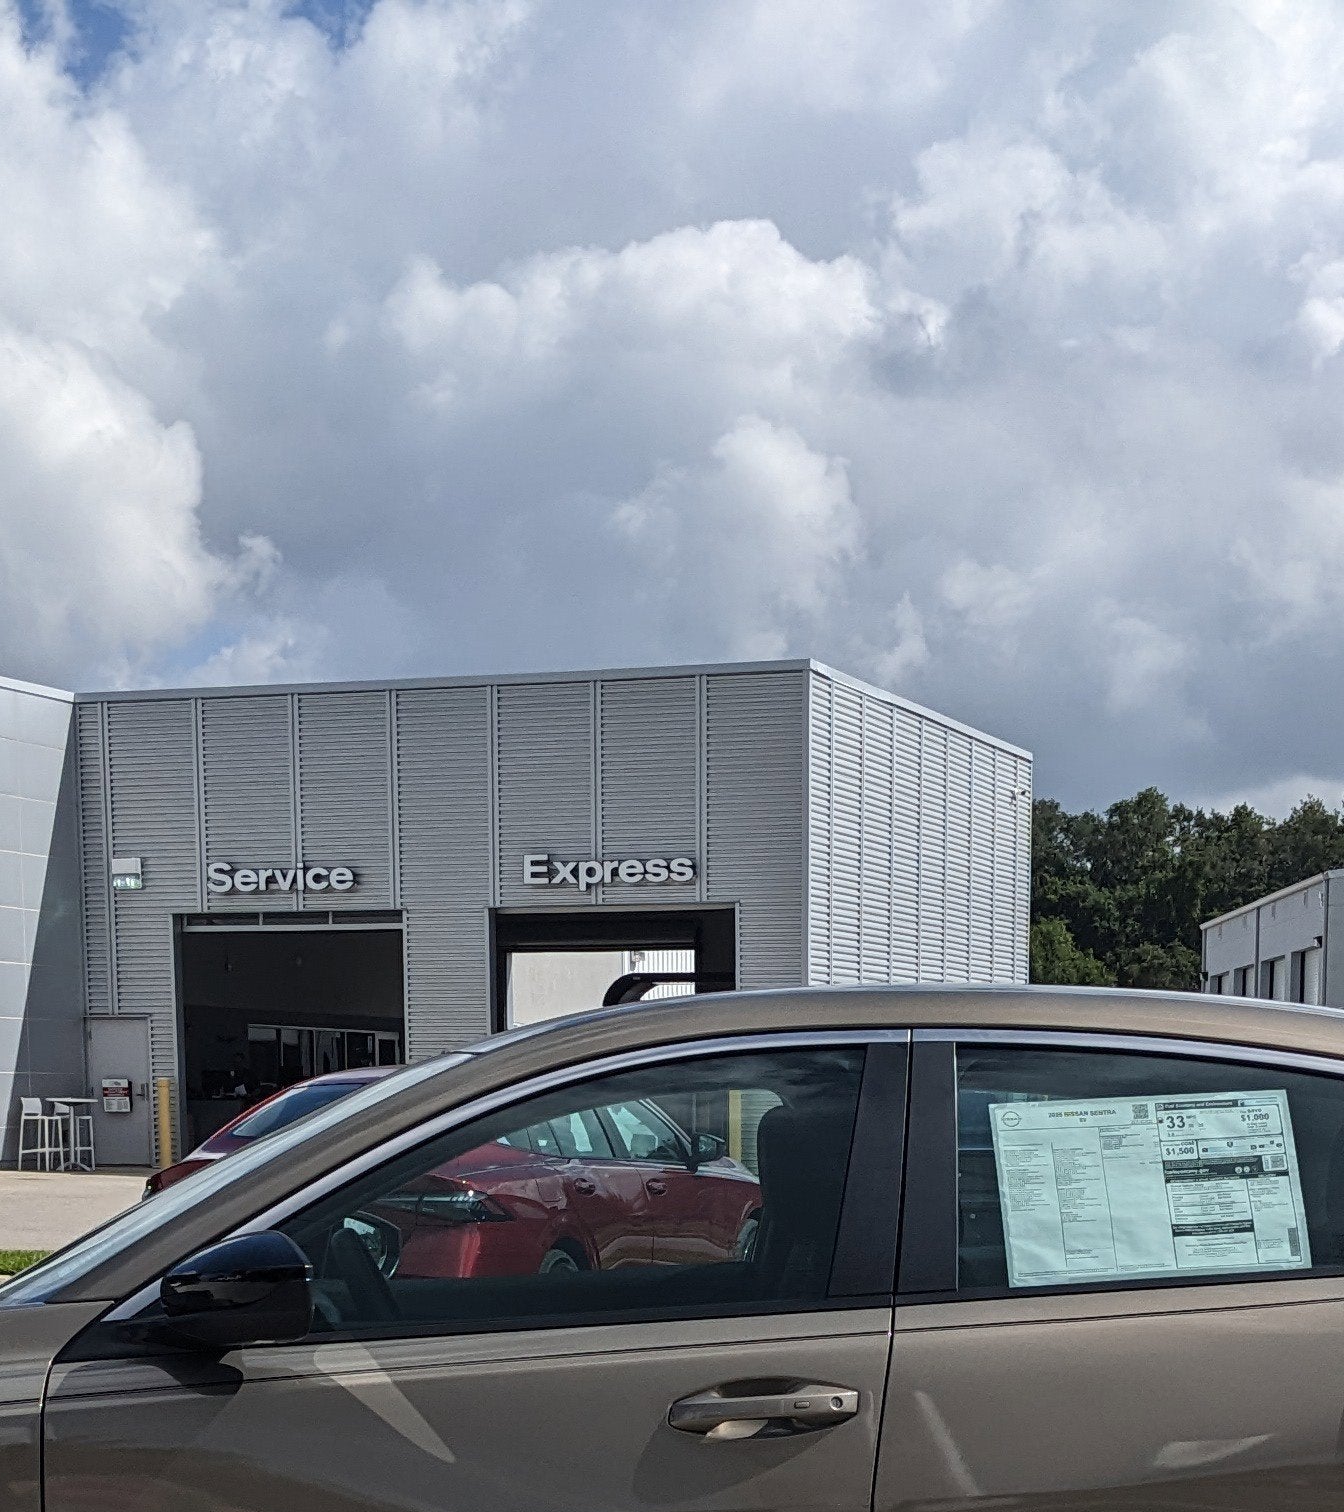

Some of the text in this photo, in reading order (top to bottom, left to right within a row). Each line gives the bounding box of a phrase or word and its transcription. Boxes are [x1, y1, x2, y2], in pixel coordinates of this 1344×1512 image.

[207, 862, 354, 893] Service
[523, 854, 694, 892] Express
[1166, 1115, 1186, 1129] 33
[1165, 1146, 1195, 1156] $1,500
